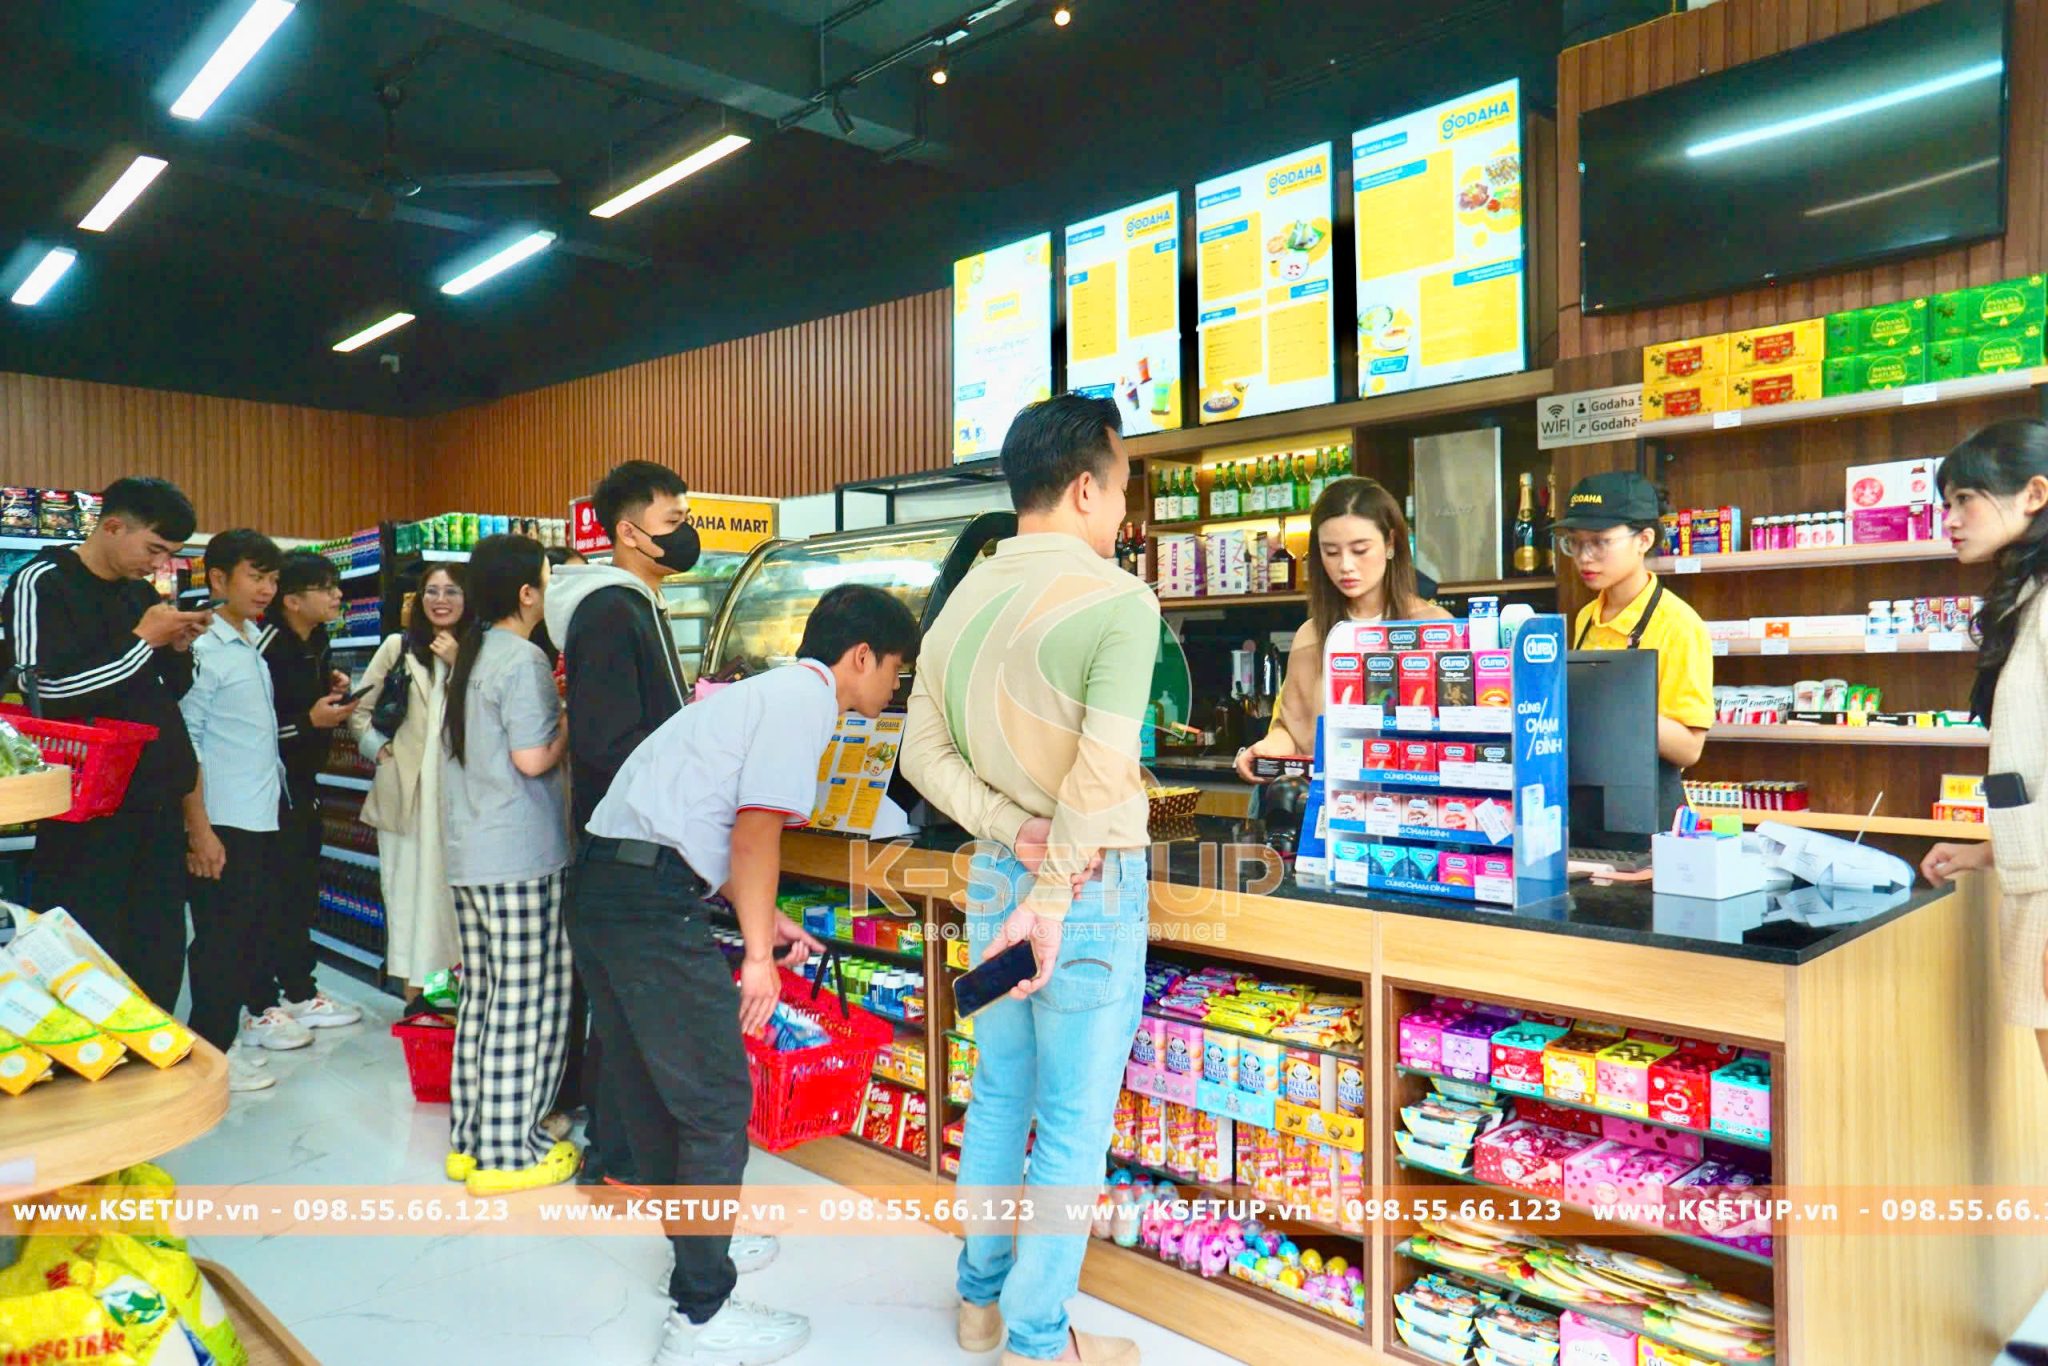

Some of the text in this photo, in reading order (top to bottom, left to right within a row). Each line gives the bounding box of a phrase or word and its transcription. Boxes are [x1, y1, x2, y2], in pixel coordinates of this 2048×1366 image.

[1591, 397, 1635, 412] Godaha
[730, 517, 768, 534] MART
[1527, 639, 1554, 656] durex
[1442, 657, 1466, 668] durex
[1288, 1079, 1317, 1091] HELLO
[1288, 1087, 1317, 1099] PANDA
[1339, 1092, 1364, 1105] PAND
